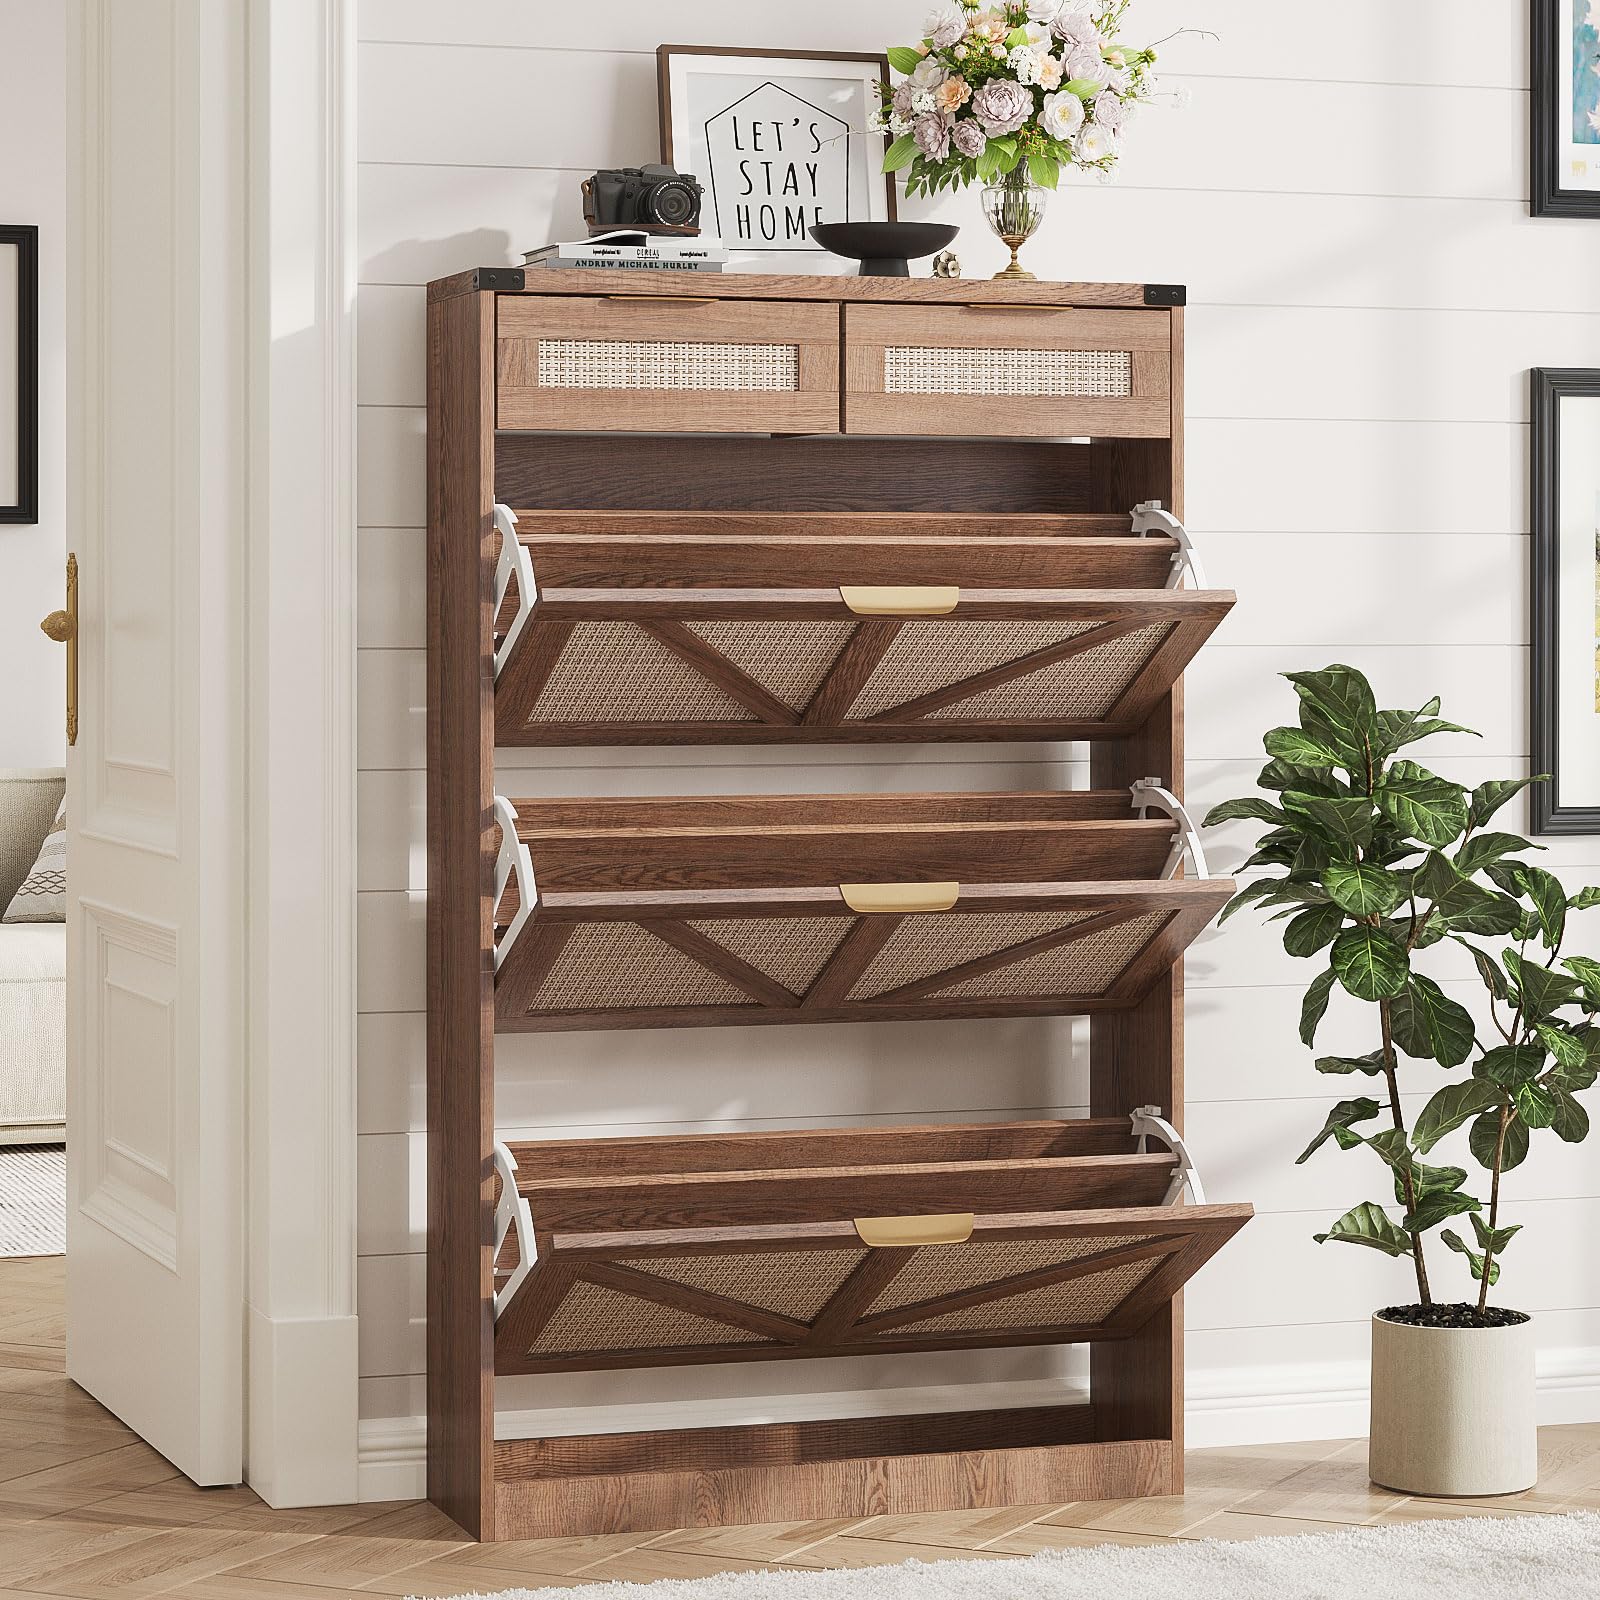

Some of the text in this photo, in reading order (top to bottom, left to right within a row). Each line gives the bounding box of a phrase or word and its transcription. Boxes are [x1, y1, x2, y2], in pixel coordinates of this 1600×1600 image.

[732, 115, 821, 153] LET'S
[739, 159, 818, 197] STAY
[575, 259, 699, 270] ANDREW MICHAEL HURLEY
